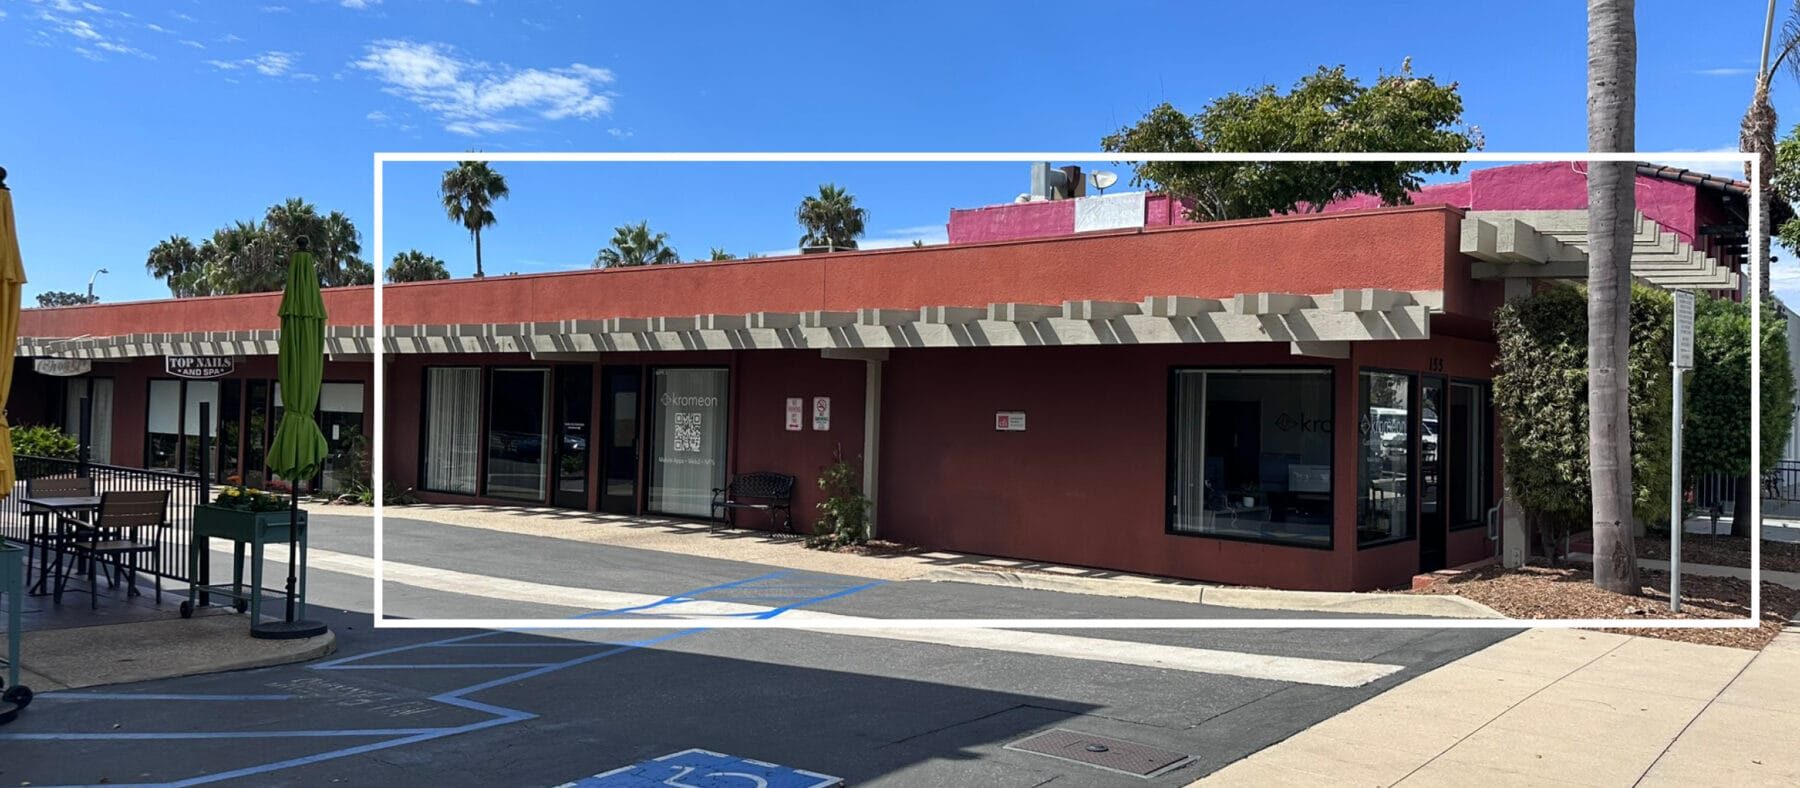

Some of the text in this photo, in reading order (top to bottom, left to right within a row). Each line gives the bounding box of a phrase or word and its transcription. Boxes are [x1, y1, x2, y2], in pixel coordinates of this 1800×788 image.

[170, 357, 231, 368] TOP NAILS
[672, 392, 718, 407] kromeon
